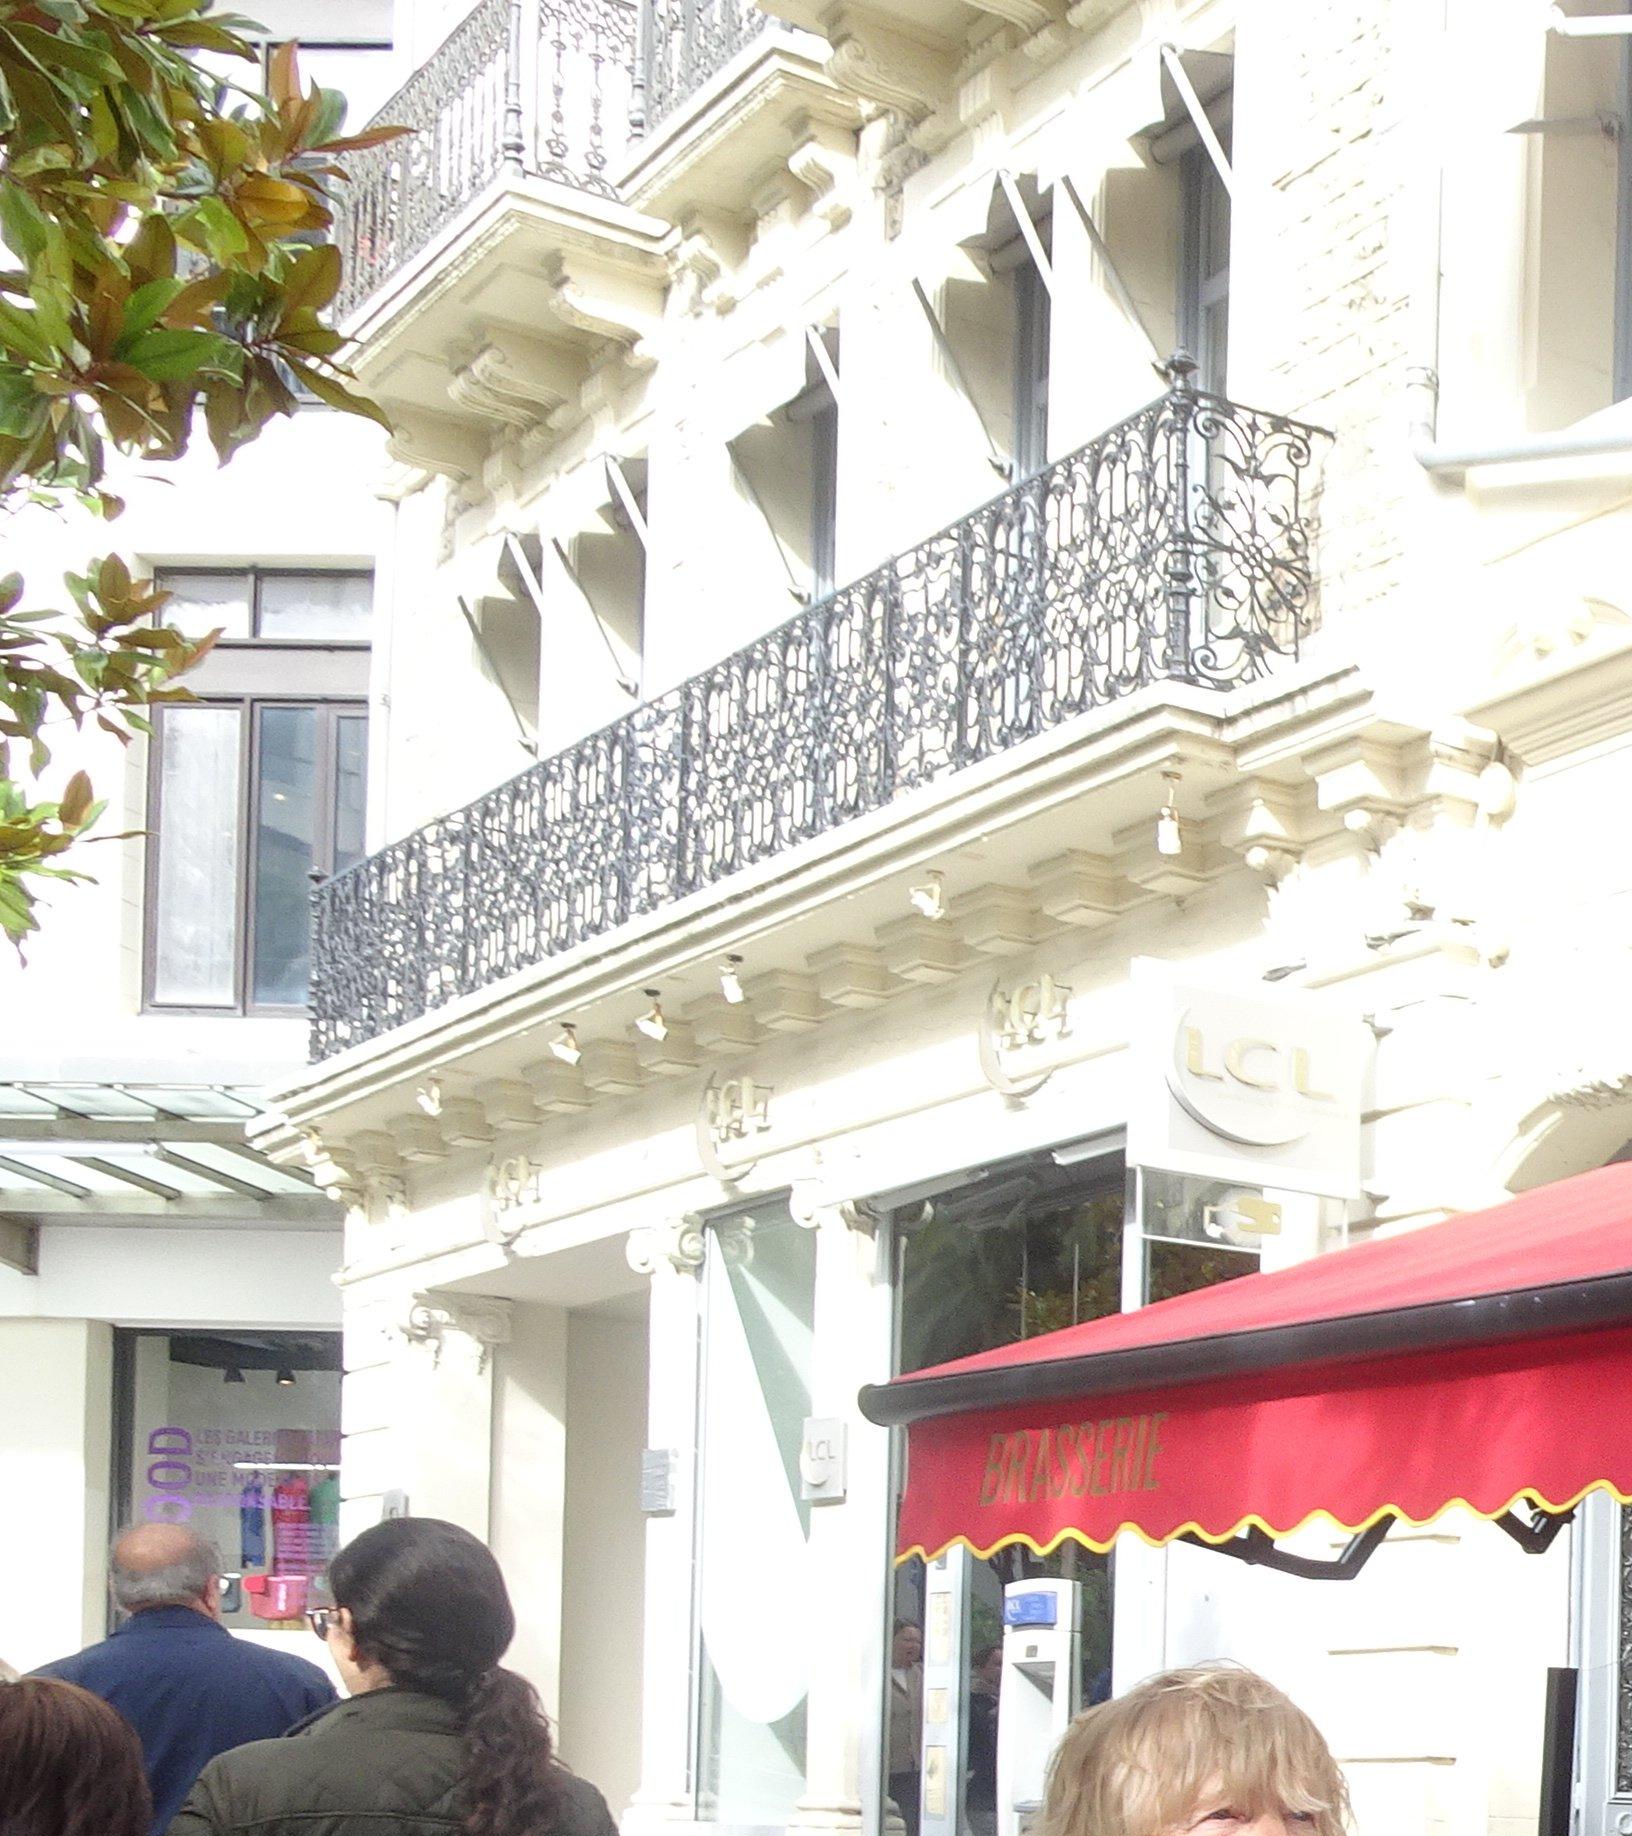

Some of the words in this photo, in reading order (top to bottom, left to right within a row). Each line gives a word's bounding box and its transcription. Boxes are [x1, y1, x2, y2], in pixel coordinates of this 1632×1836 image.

[1183, 1024, 1336, 1104] LCL
[146, 1425, 194, 1524] OOD
[979, 1410, 1169, 1508] BRASSERIE
